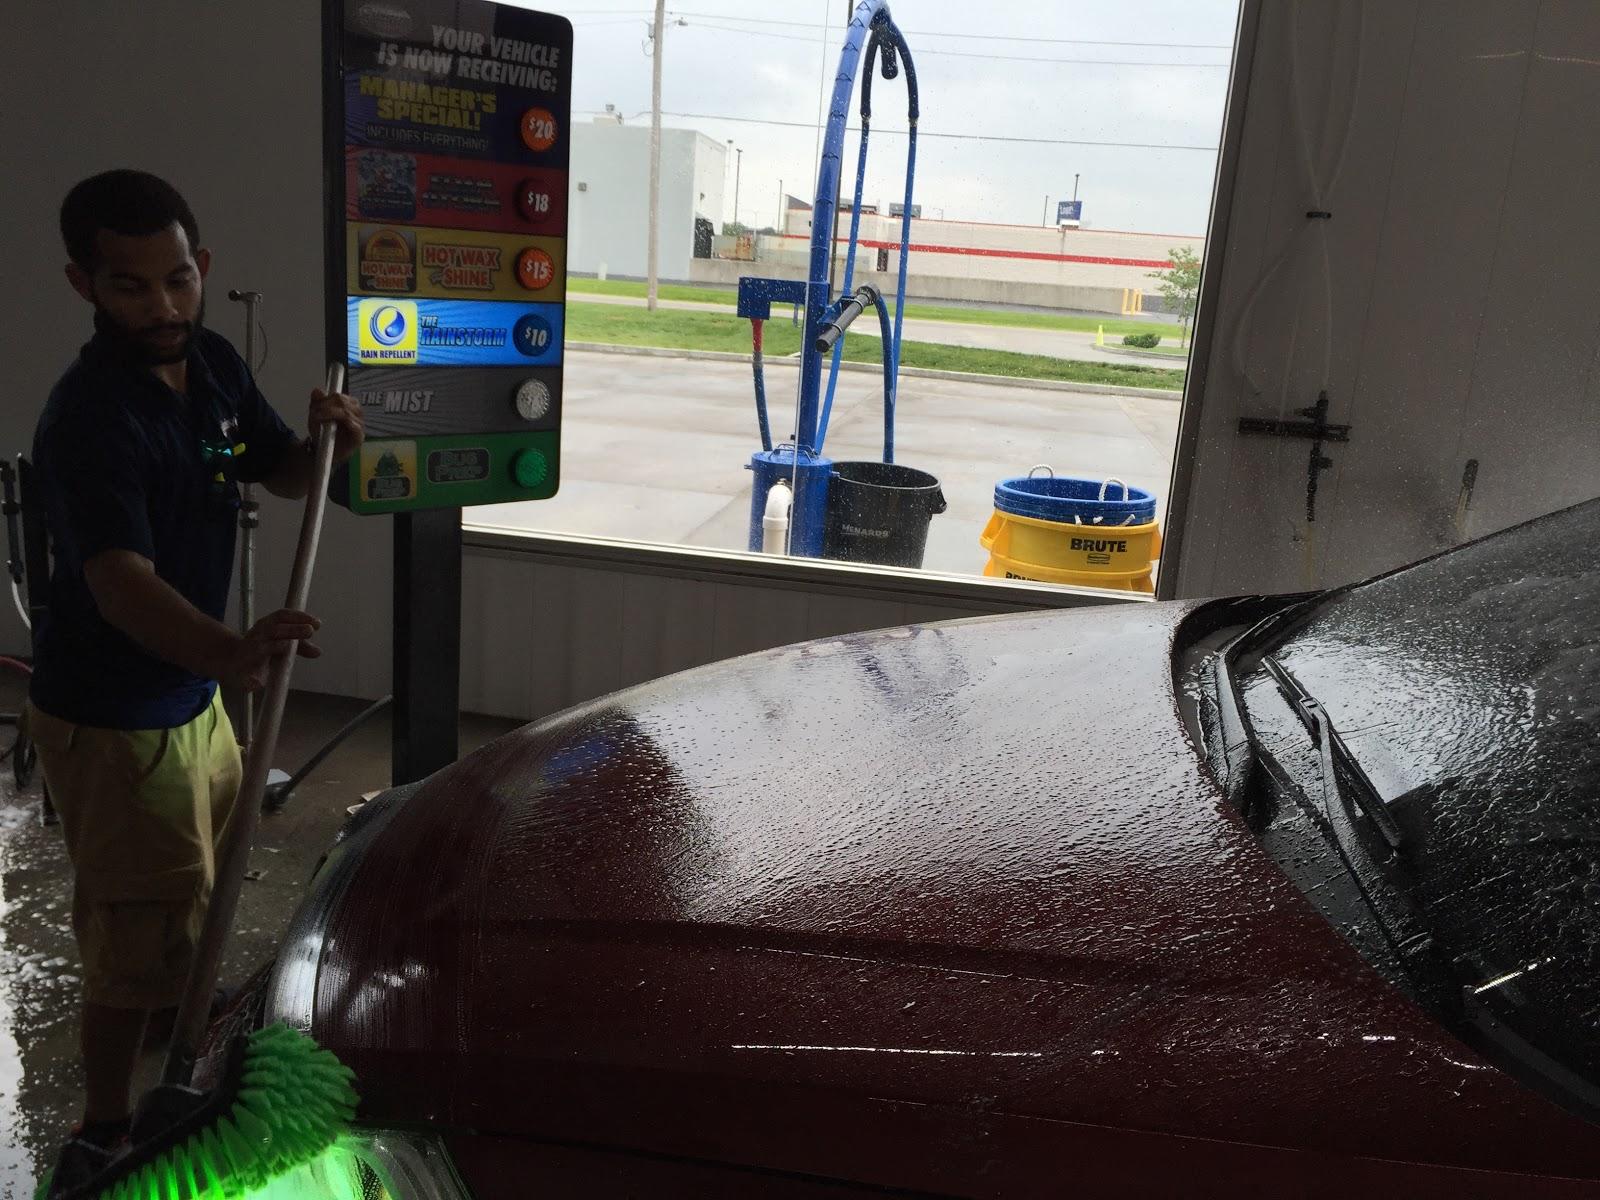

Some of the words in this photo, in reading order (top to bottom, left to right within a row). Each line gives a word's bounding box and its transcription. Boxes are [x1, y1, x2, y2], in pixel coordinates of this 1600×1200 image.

[432, 25, 488, 55] YOUR
[490, 36, 560, 67] VEHICLE
[377, 43, 399, 66] IS
[405, 47, 452, 74] NOW
[457, 56, 558, 92] RECEIVING:
[360, 75, 497, 113] MANAGER'S
[377, 98, 481, 131] SPECIAL!
[367, 125, 421, 143] INCLUDES
[529, 118, 555, 140] $20
[528, 192, 549, 212] $18
[425, 247, 455, 264] HOT
[461, 248, 498, 267] WAX
[362, 262, 384, 275] HOT
[386, 264, 412, 276] WAX
[443, 268, 489, 287] SHINE
[526, 260, 549, 279] $15
[375, 276, 406, 288] SHINE
[421, 316, 438, 327] THE
[421, 328, 507, 346] RAINSTORM
[525, 326, 547, 347] $10
[361, 349, 378, 359] RAIN
[379, 350, 416, 359] REPELLENT
[361, 391, 383, 405] THE
[385, 391, 434, 413] MIST
[1070, 538, 1128, 553] BRUTE
